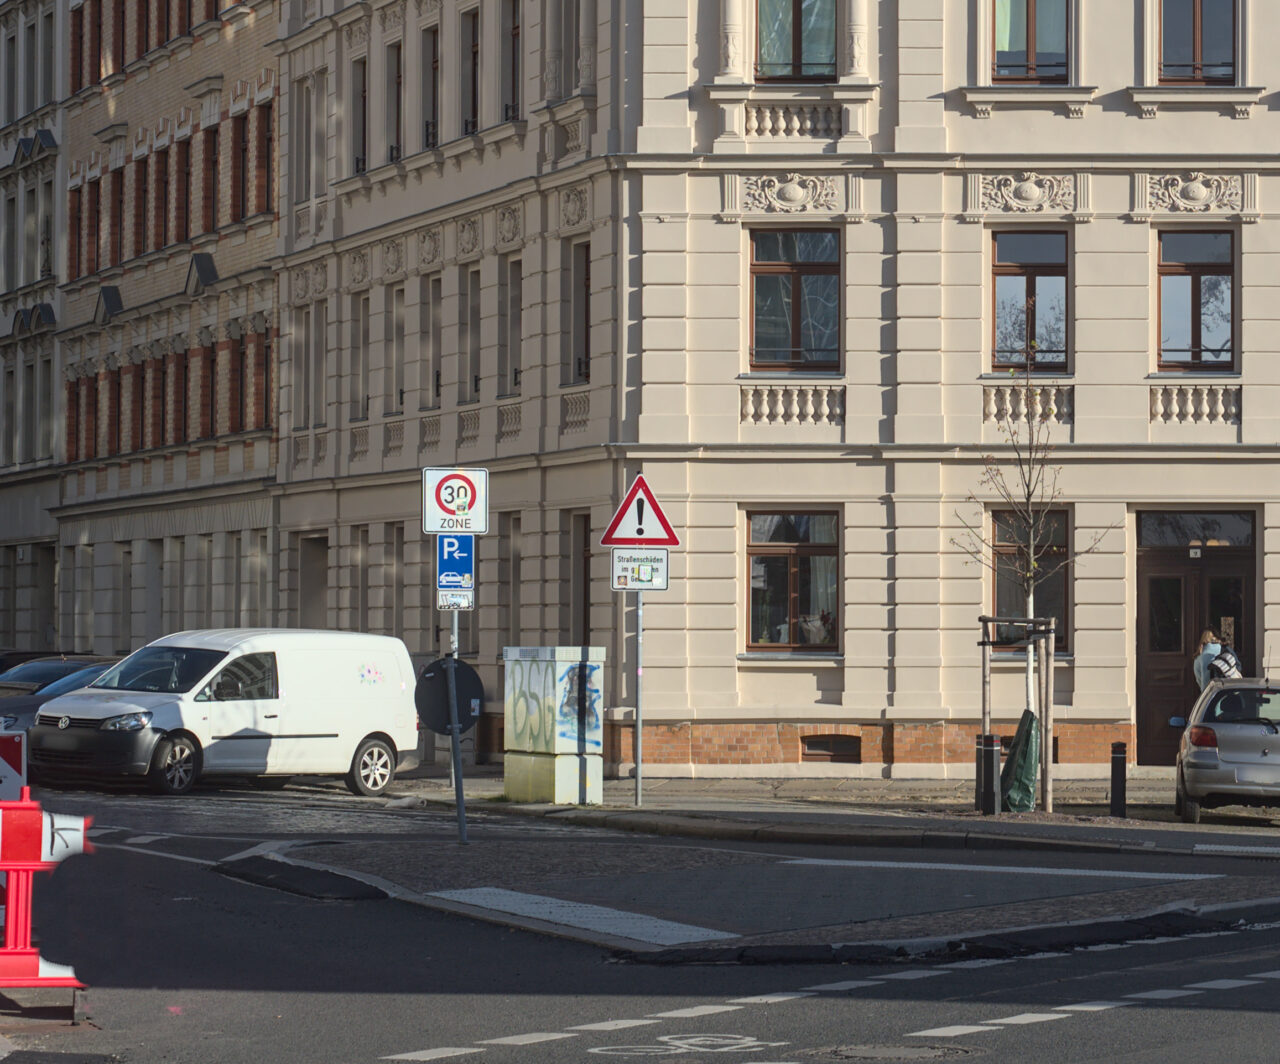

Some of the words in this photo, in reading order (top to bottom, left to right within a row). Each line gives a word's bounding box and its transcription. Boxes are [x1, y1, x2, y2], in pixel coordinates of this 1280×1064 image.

[444, 485, 468, 504] 30
[440, 518, 471, 529] ZONE
[443, 537, 459, 560] P
[617, 555, 663, 563] Straßenschäden
